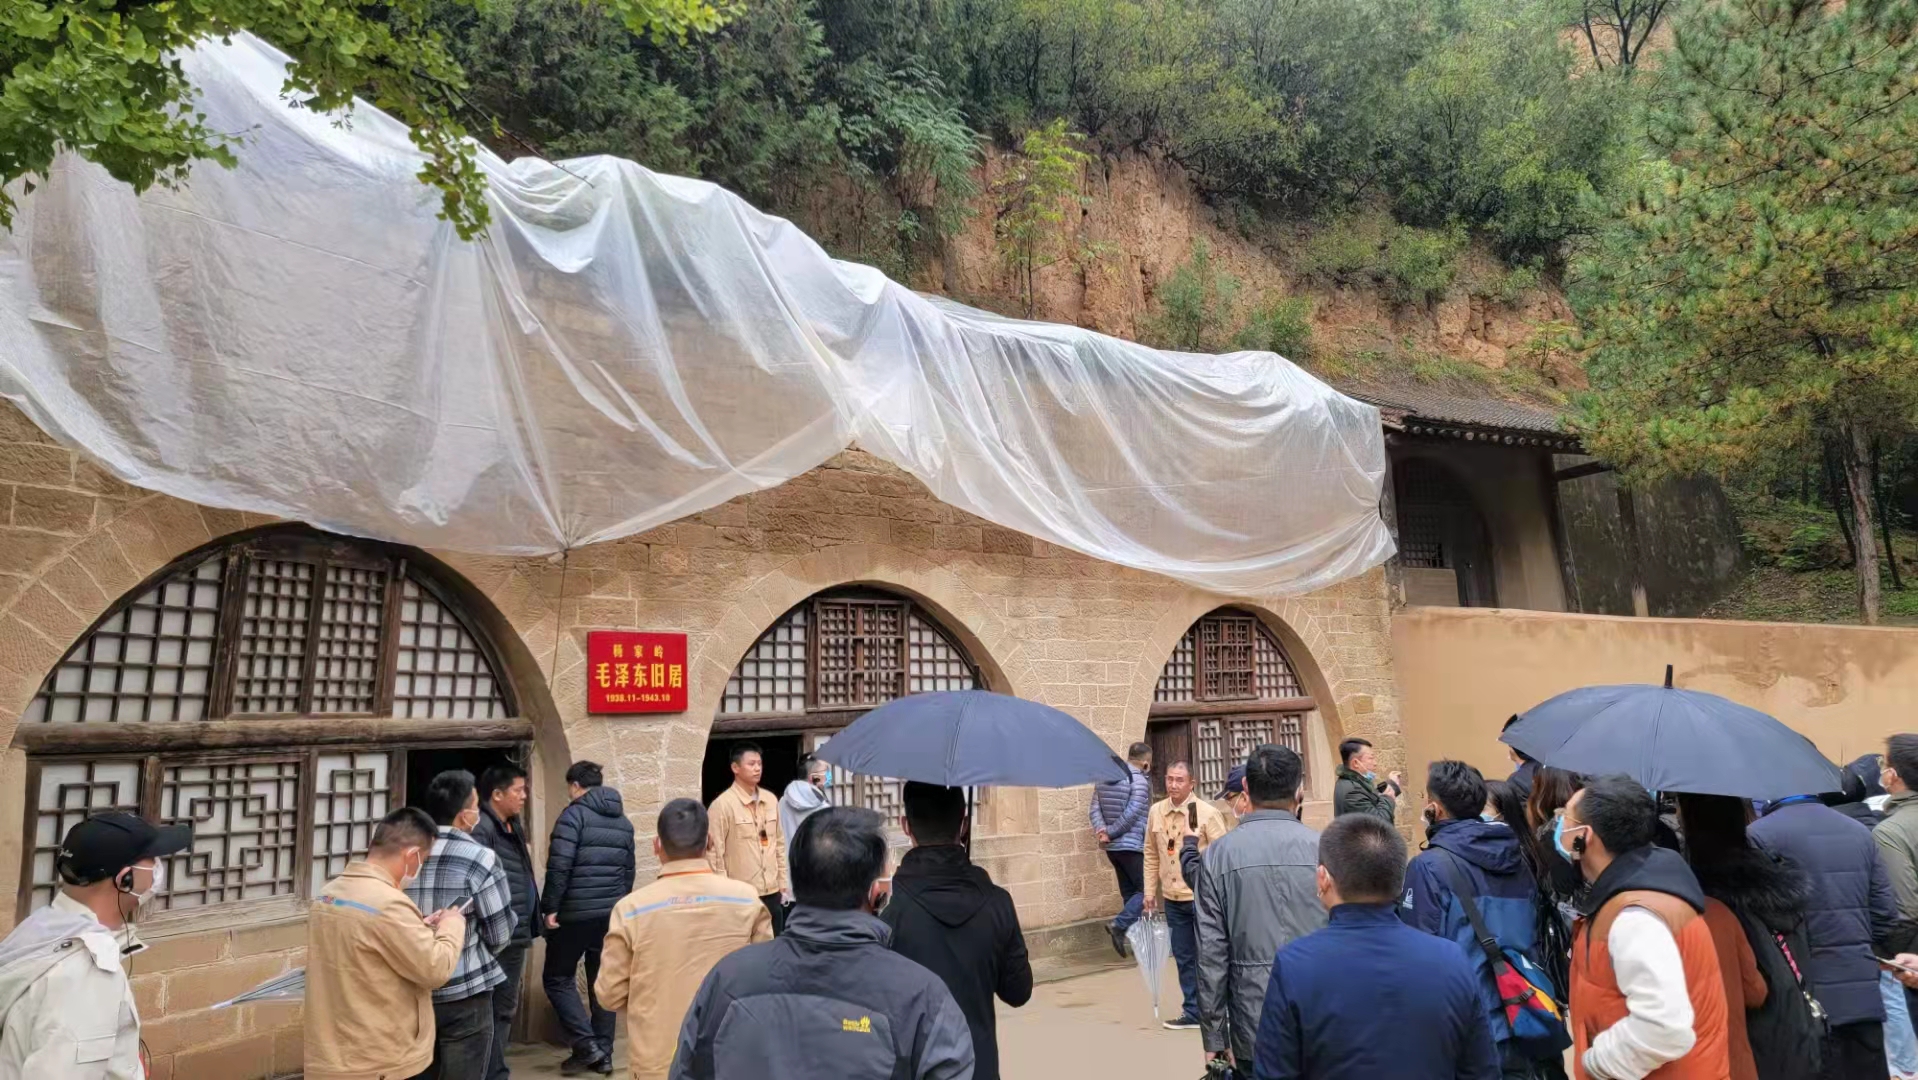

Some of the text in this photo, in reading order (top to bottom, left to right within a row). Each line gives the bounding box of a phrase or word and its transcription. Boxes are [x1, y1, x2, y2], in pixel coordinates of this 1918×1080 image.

[595, 663, 682, 688] 毛泽东旧居
